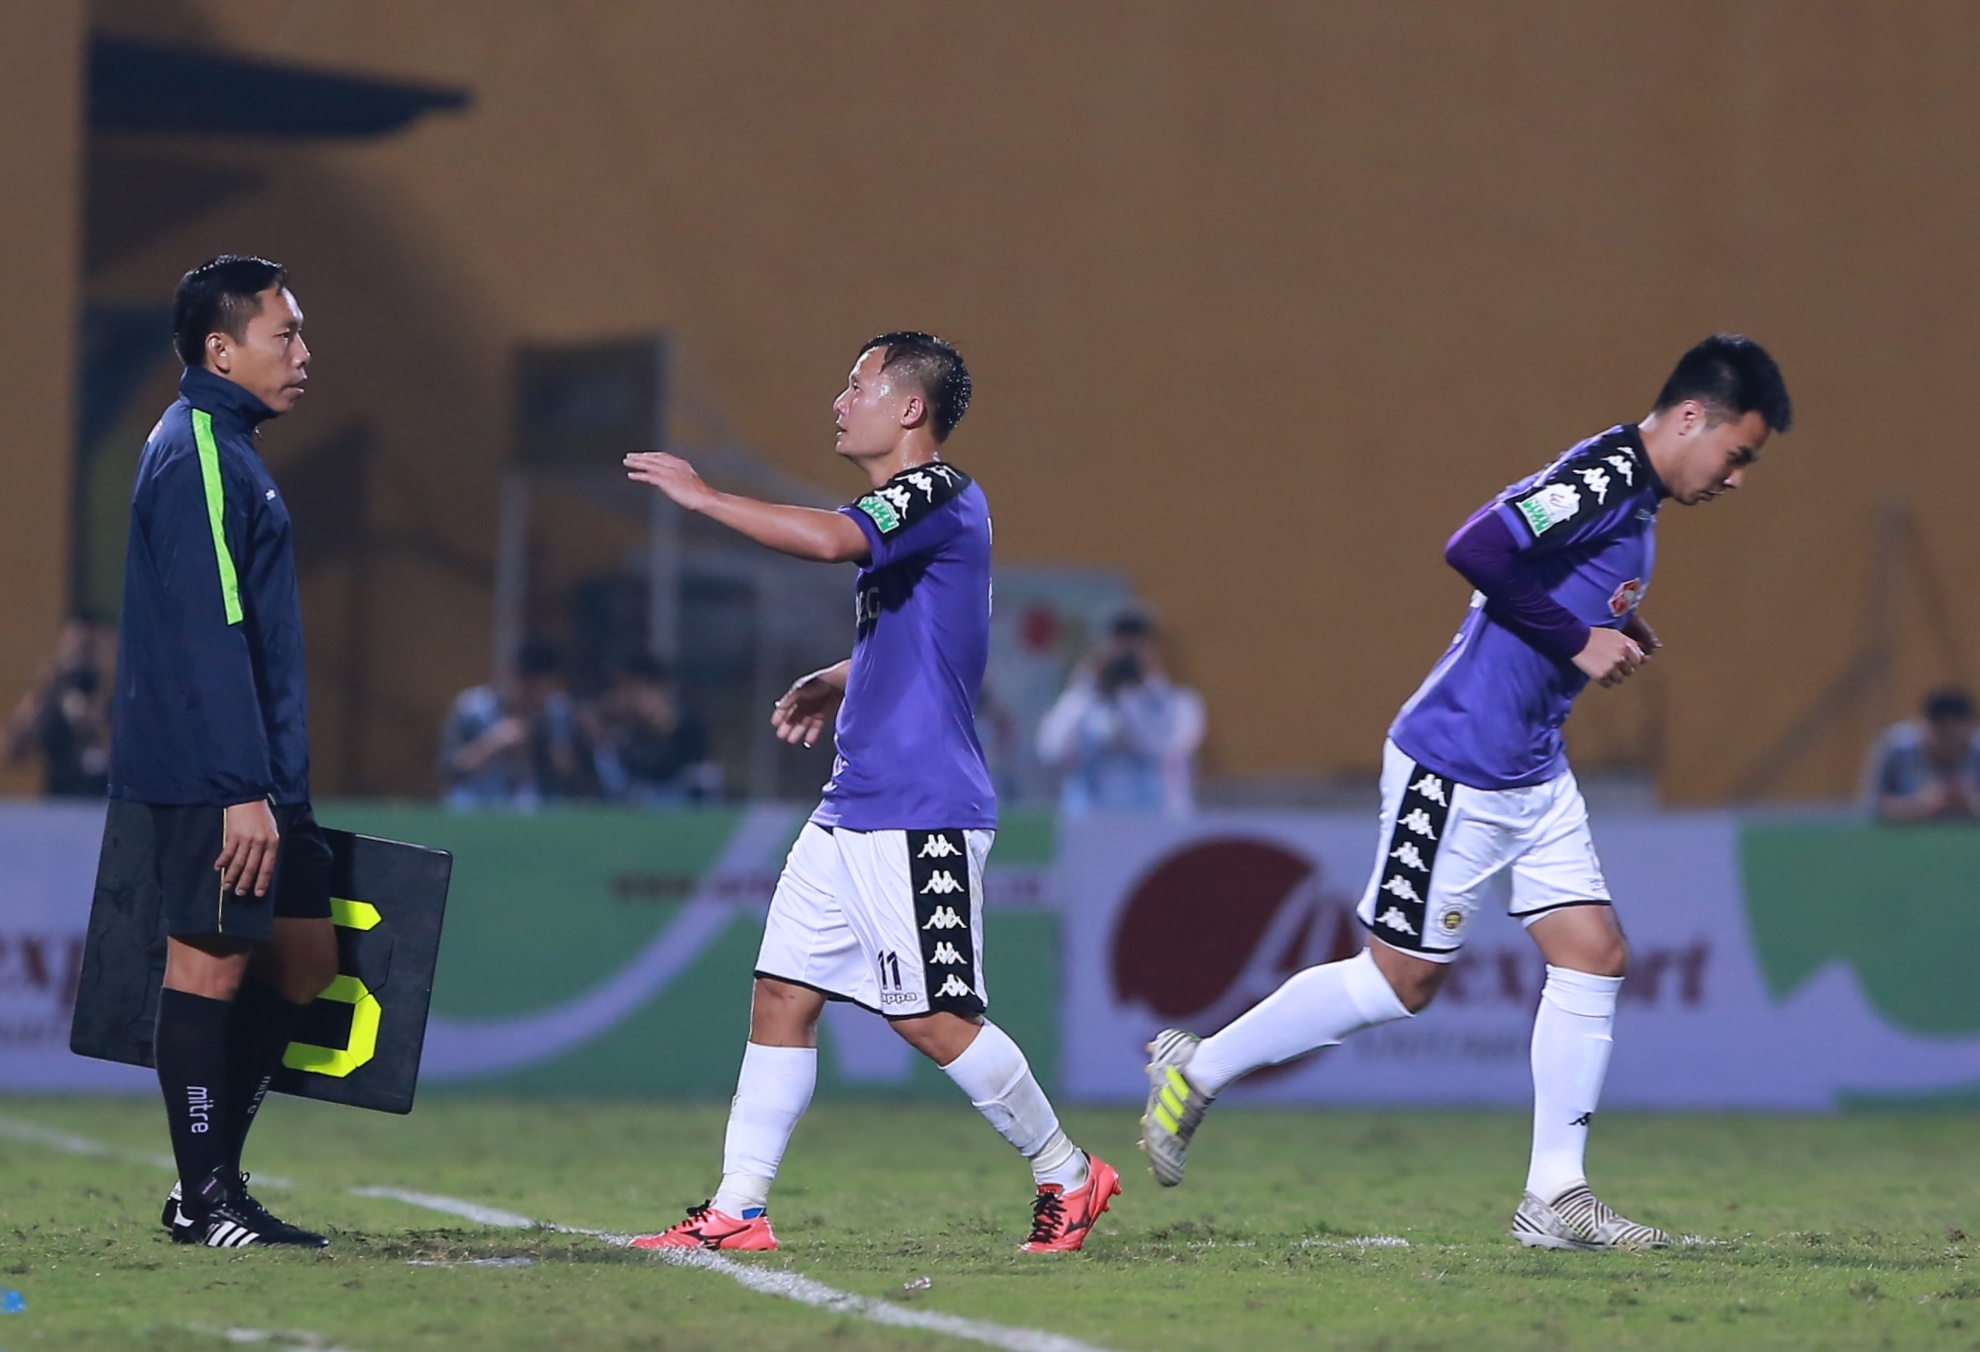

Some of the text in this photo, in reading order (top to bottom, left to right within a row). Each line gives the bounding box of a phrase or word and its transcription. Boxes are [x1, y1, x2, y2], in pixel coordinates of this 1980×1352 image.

[878, 950, 902, 990] 11
[881, 992, 917, 1004] appa
[186, 1085, 214, 1134] mitre
